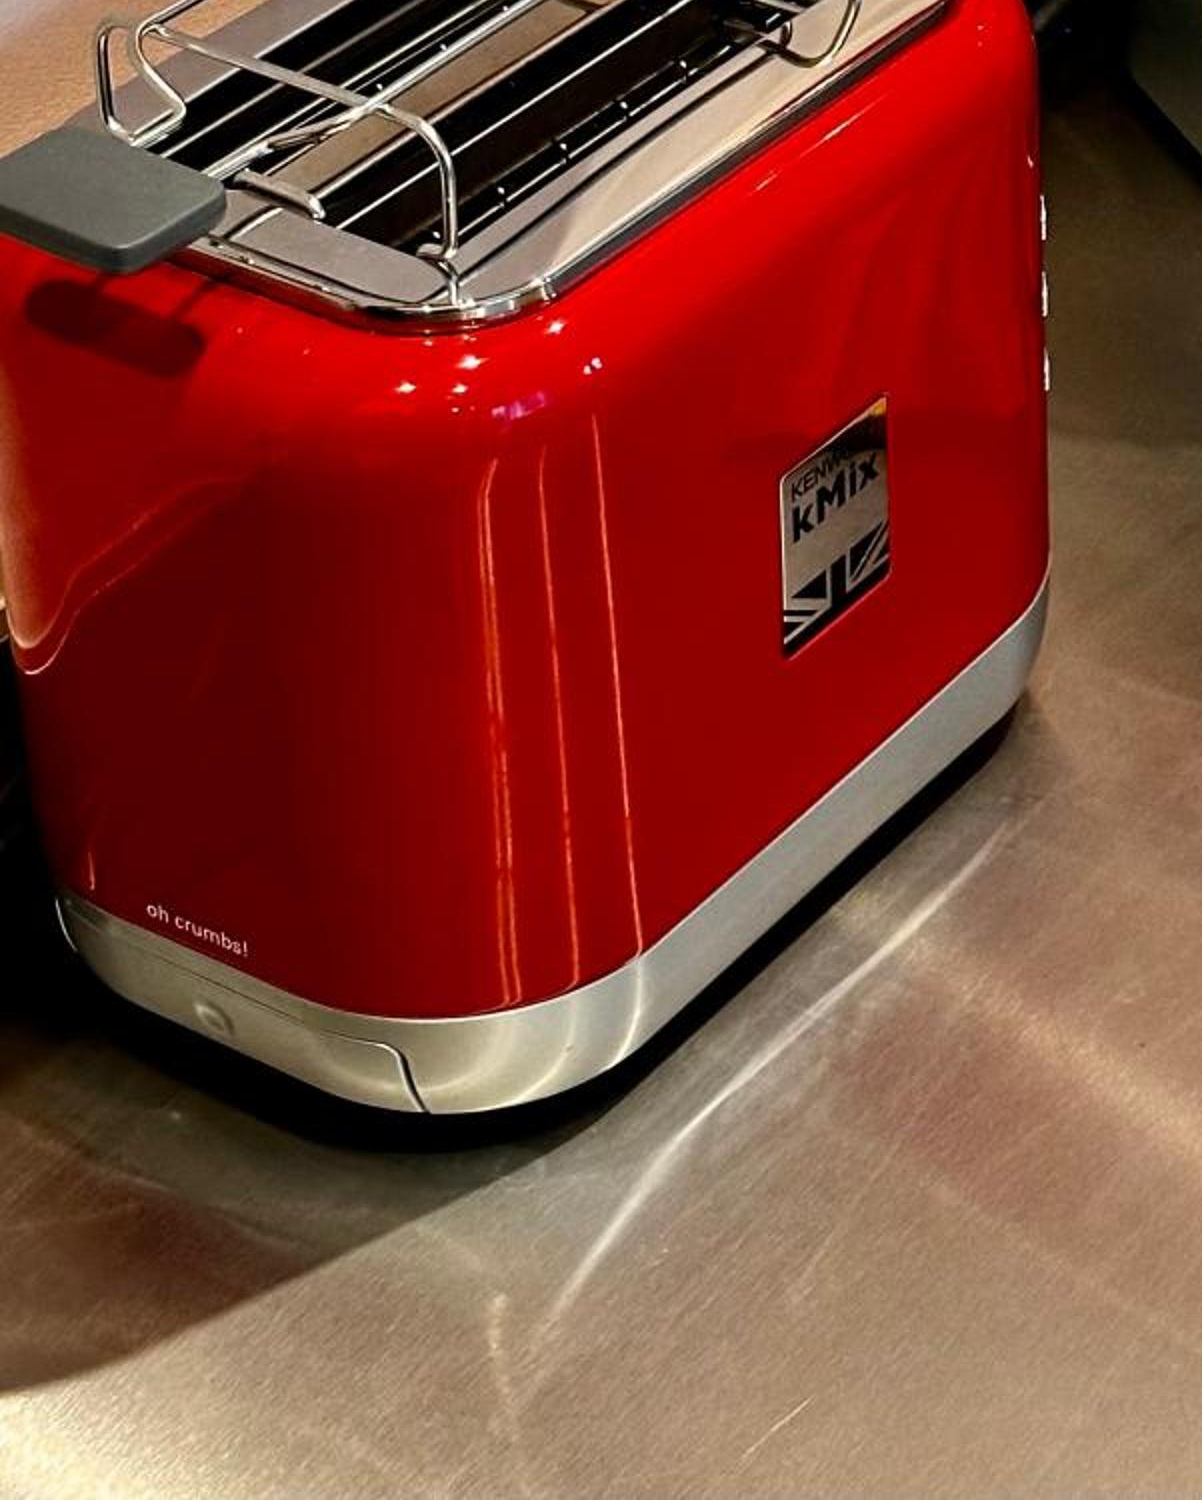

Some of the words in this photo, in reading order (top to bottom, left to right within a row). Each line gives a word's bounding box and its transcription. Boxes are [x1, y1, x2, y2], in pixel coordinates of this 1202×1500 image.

[791, 442, 850, 503] KENW
[792, 451, 880, 544] kMix
[146, 904, 169, 924] oh
[175, 916, 249, 958] crumbs!
